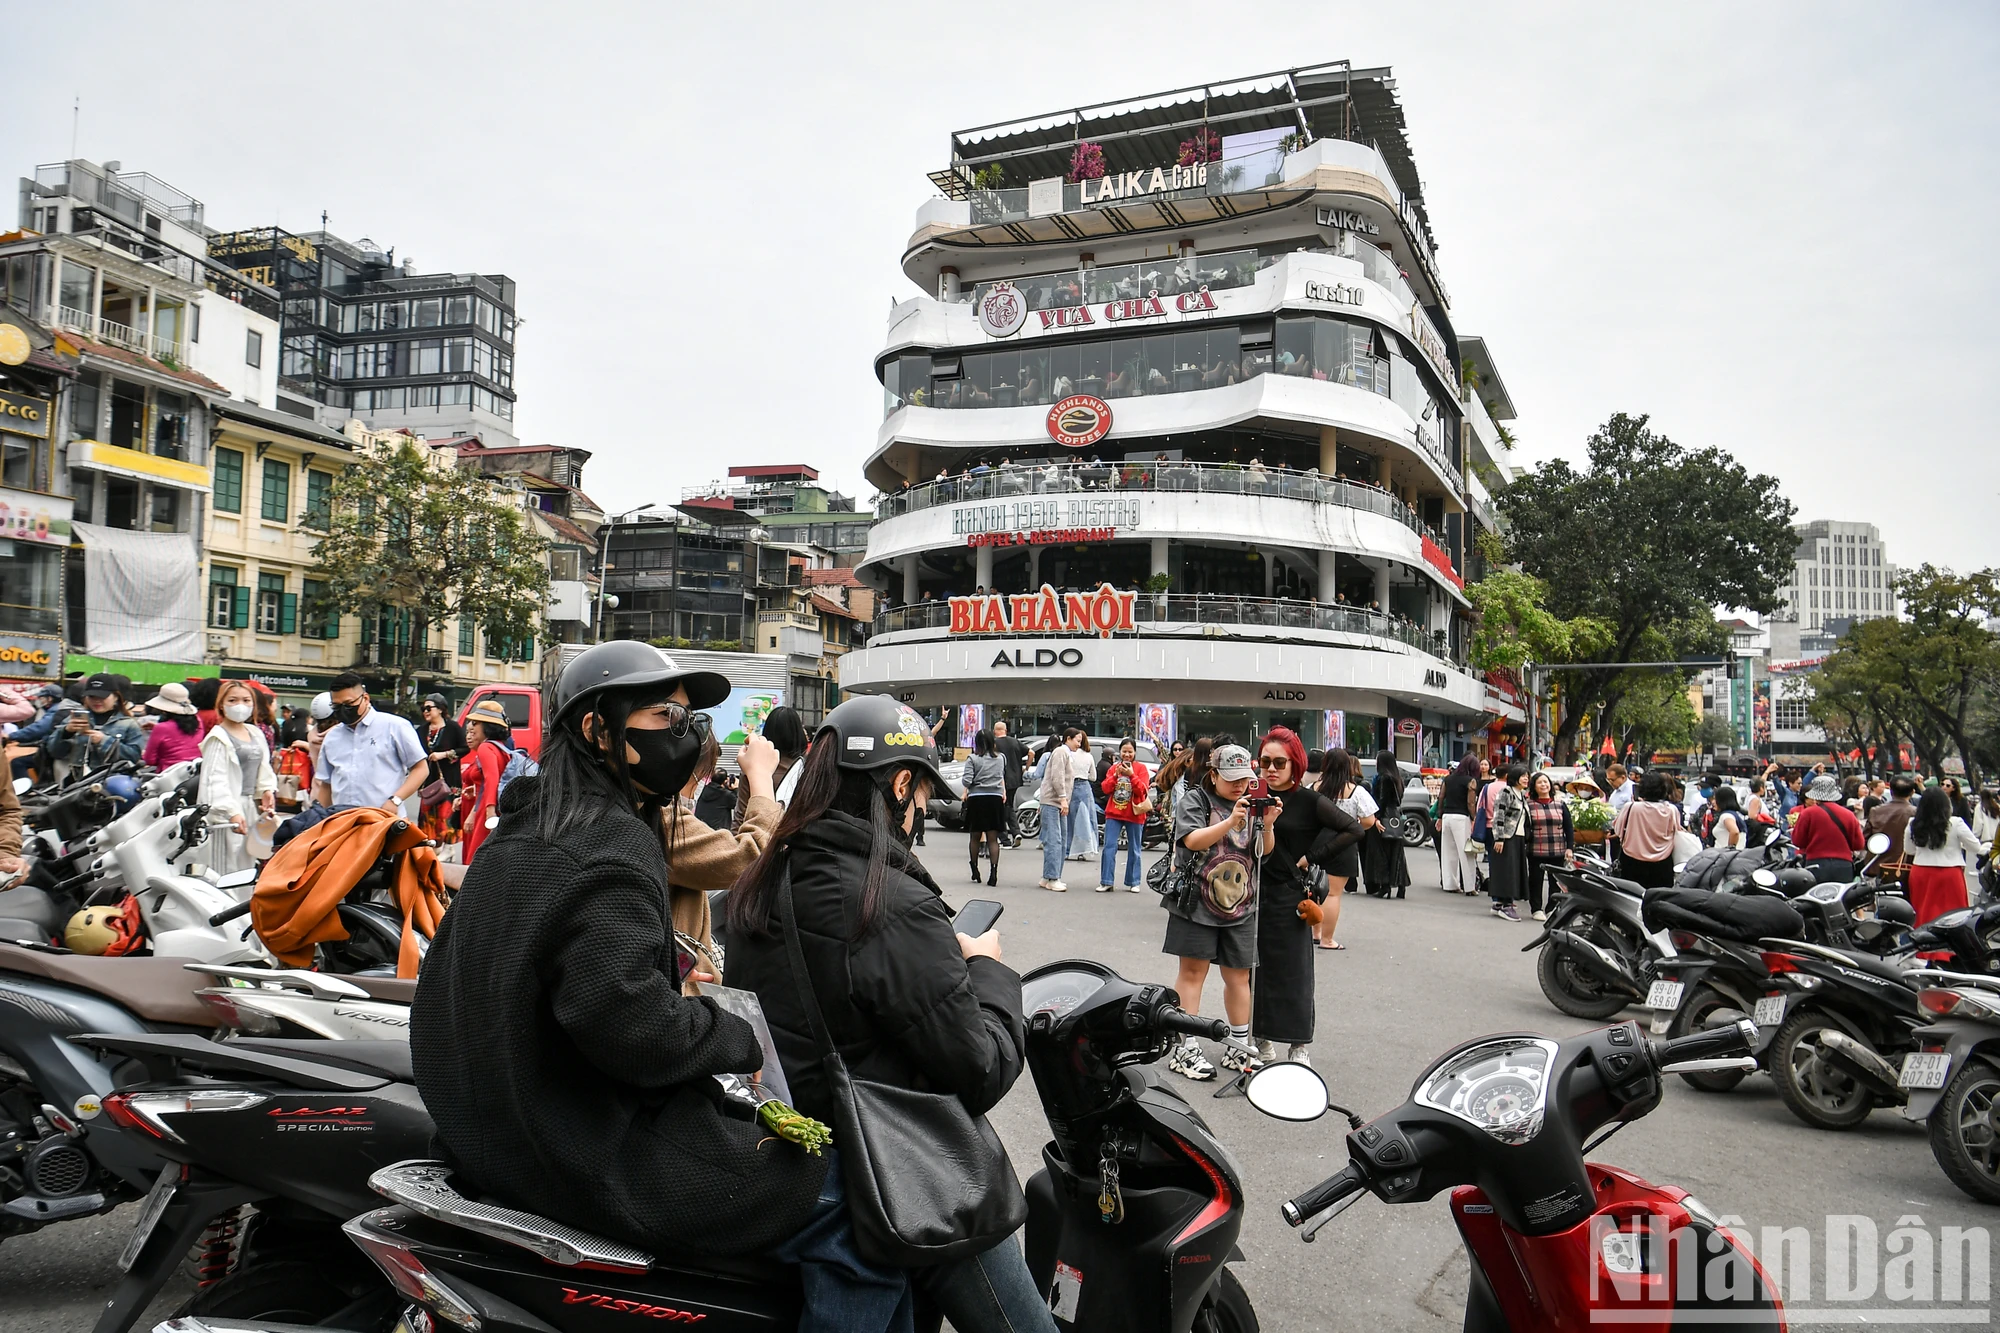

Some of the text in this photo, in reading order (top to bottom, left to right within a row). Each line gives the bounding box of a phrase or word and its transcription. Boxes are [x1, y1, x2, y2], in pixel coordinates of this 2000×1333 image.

[1080, 167, 1168, 204] LAIKA
[1171, 161, 1207, 190] Café
[1317, 206, 1367, 233] LAIKA
[1347, 287, 1364, 306] 10
[1037, 285, 1219, 330] VUA CHẢ CÁ
[1049, 398, 1108, 422] HIGHLANDS
[1056, 429, 1102, 445] COFFEE
[952, 499, 1141, 535] HANOI 1930 BISTRO
[967, 527, 1117, 548] COFFEE & RESTAURANT
[949, 585, 1135, 639] BIA HÀ NỘI
[991, 648, 1083, 668] ALDO
[249, 674, 309, 687] Vietcombank
[1423, 668, 1447, 689] ALDO
[1263, 689, 1306, 702] ALDO
[884, 732, 924, 747] GOOD
[1833, 965, 1890, 987] VISION
[1647, 994, 1678, 1008] 459.60
[1908, 1055, 1942, 1070] 29-D1
[1901, 1070, 1942, 1086] 807.89
[276, 1124, 340, 1132] SPECIAL
[1178, 1254, 1212, 1265] HONDA
[562, 1287, 707, 1324] VISION
